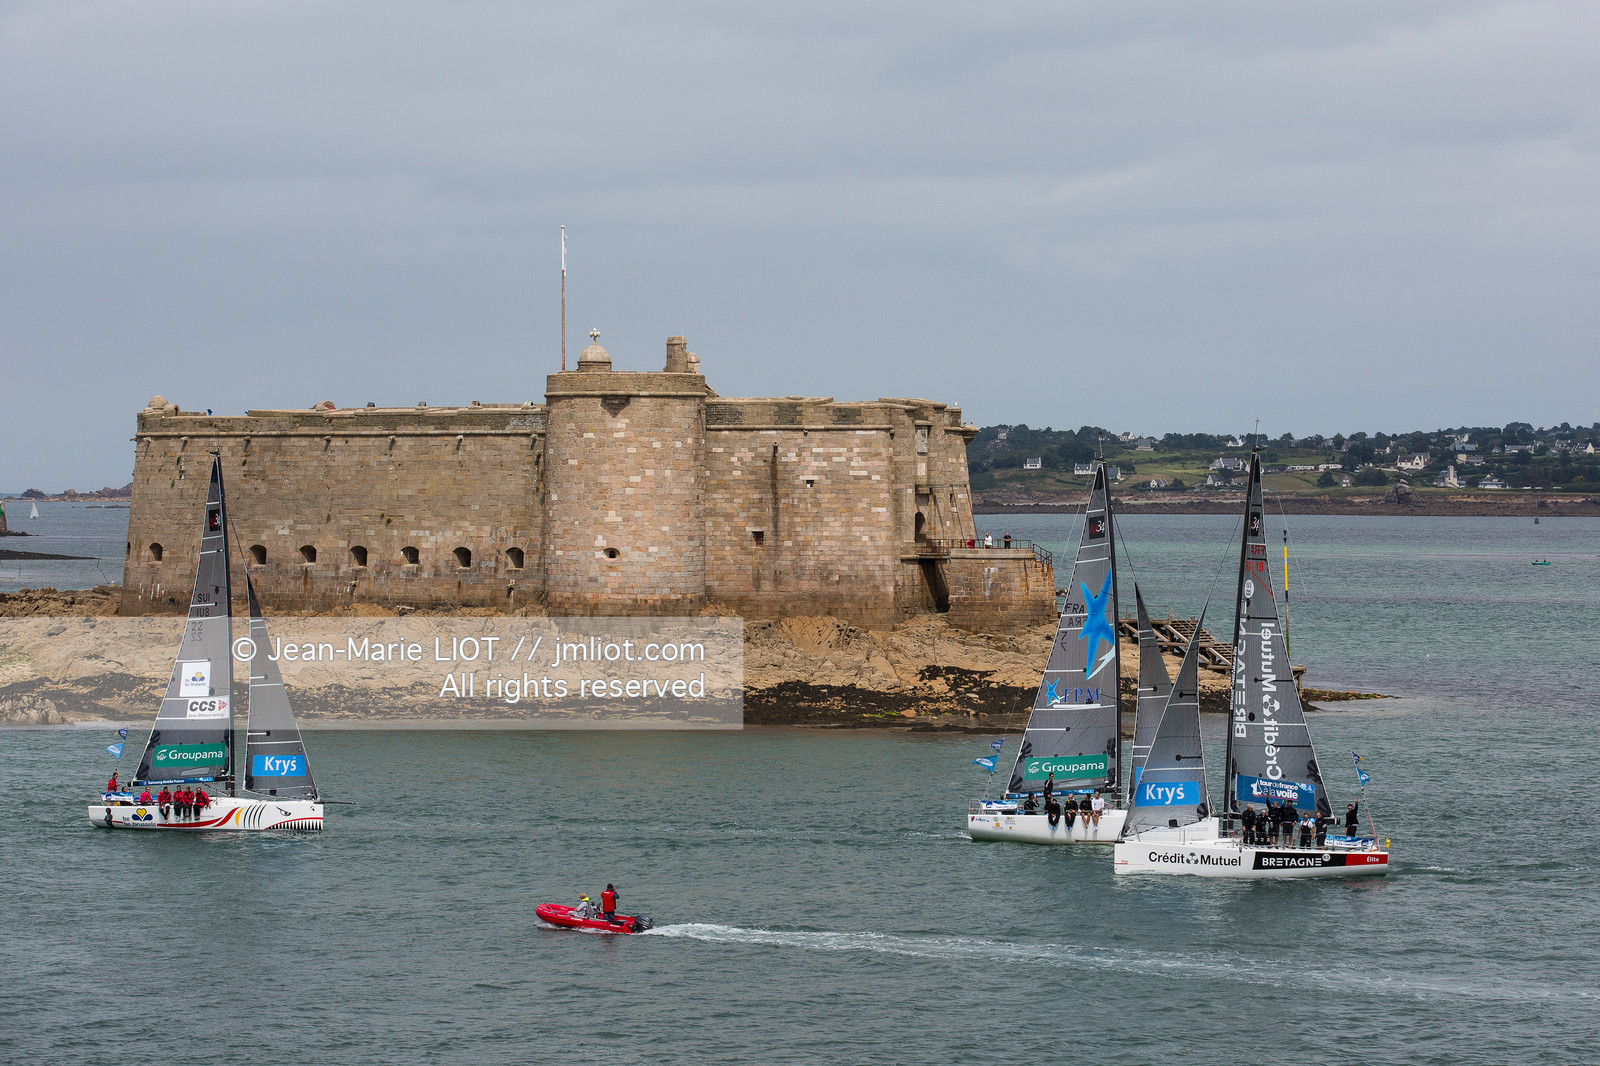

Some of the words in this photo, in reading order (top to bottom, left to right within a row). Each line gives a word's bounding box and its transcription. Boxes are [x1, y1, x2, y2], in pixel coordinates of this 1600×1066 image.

[1244, 560, 1254, 572] RA
[1256, 561, 1264, 572] 18
[1065, 603, 1085, 614] FRA
[191, 622, 203, 631] 22
[1061, 632, 1067, 640] 7
[1061, 687, 1100, 703] TPM
[190, 701, 216, 712] CCS
[169, 750, 223, 761] Groupama
[1042, 761, 1105, 773] Groupama
[1276, 789, 1298, 799] voile
[1149, 851, 1185, 863] Crédit
[1201, 855, 1241, 866] Mutuel
[1262, 857, 1322, 867] BRETAGNE
